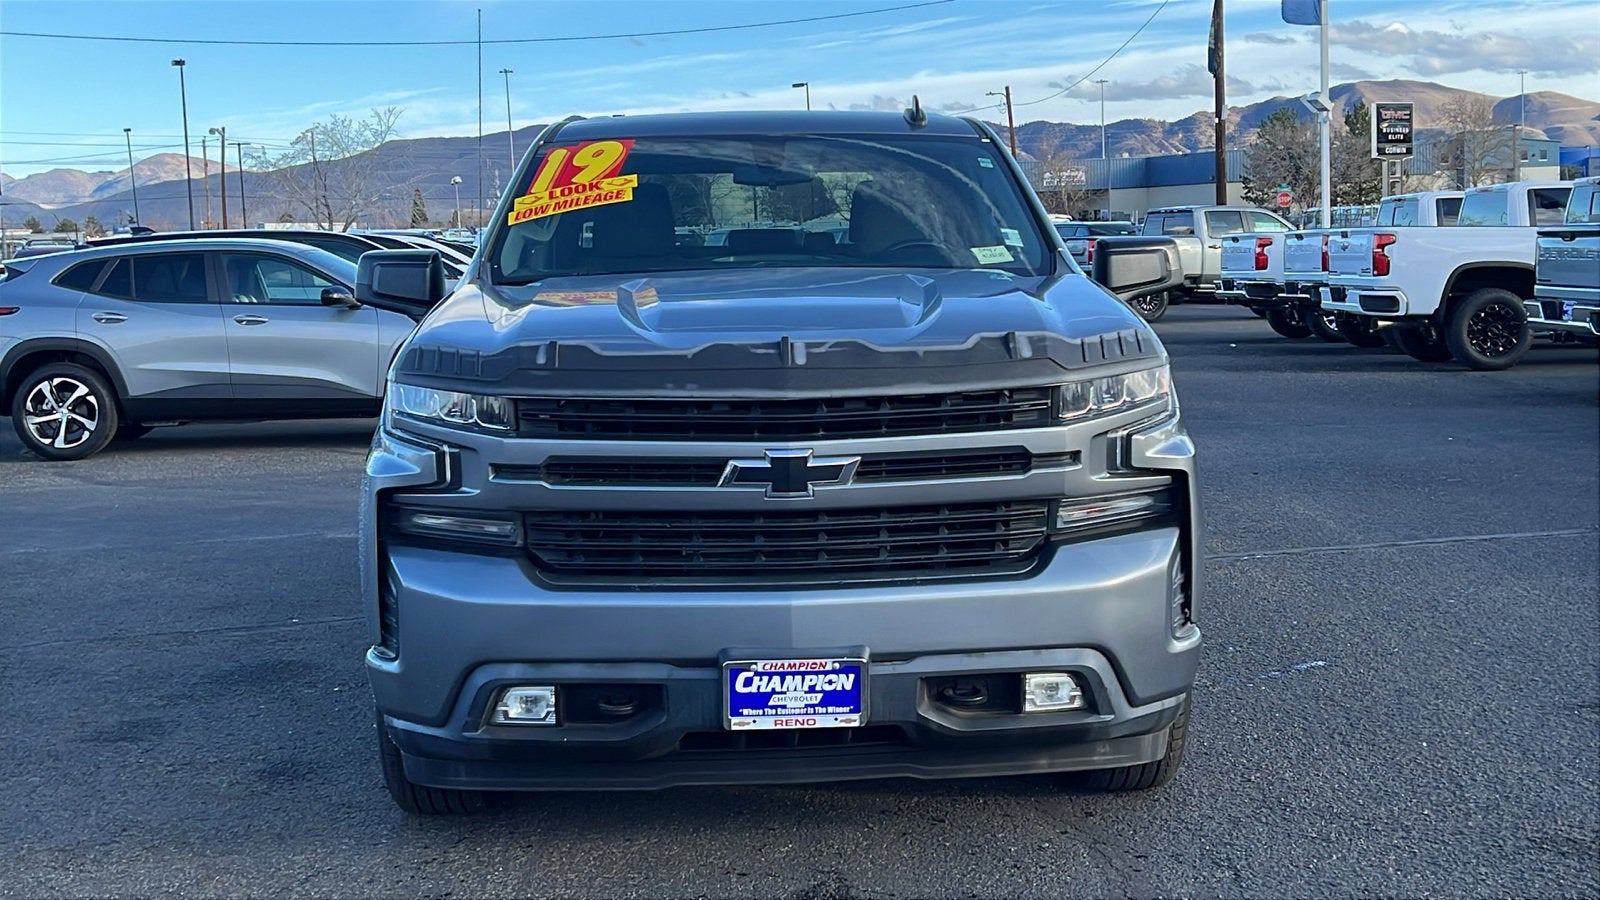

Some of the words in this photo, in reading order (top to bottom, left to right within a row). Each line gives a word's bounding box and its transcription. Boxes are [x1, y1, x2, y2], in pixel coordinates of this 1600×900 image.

[1381, 110, 1410, 119] GMC
[530, 140, 625, 193] 19
[548, 181, 602, 200] LOOK
[514, 204, 549, 222] LOW
[552, 189, 625, 212] MILEAGE
[762, 662, 828, 671] CHAMPION
[735, 671, 855, 694] CHAMPION
[772, 695, 819, 703] CHEVROLET
[777, 707, 806, 715] Customer
[815, 706, 827, 714] The
[774, 718, 817, 727] RENO
